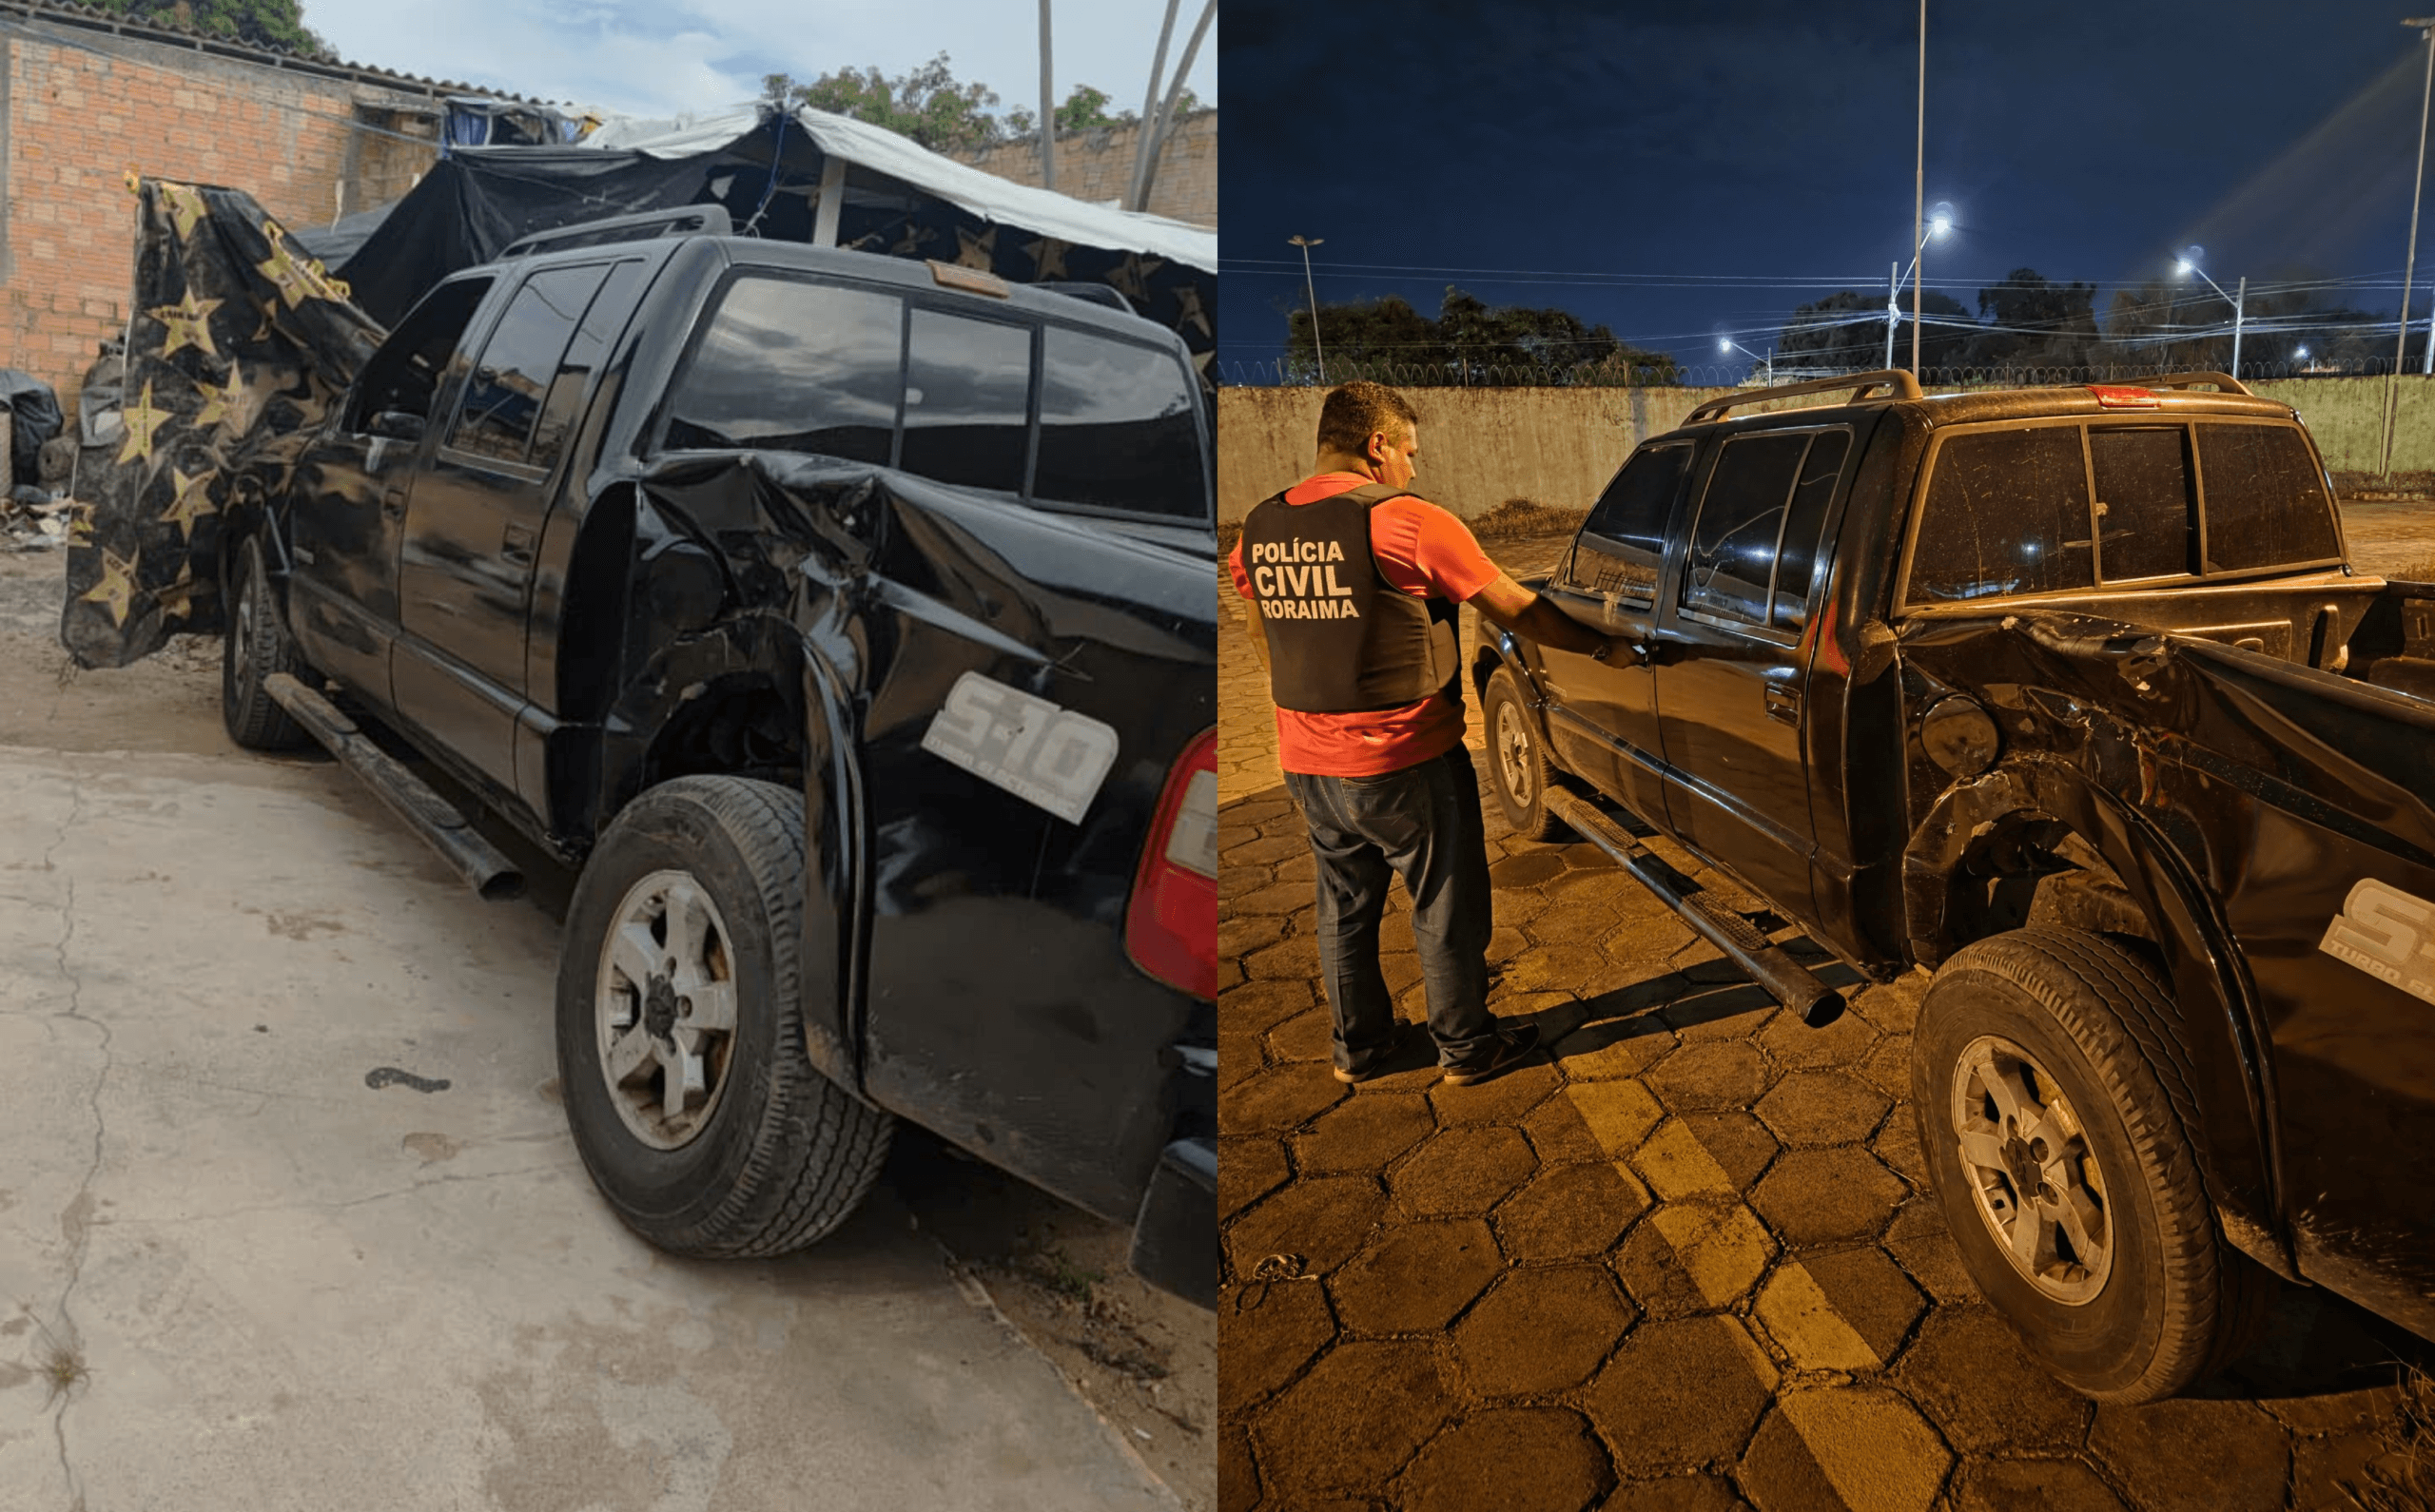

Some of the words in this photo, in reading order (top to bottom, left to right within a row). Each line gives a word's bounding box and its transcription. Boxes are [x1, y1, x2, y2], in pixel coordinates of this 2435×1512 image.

[1252, 537, 1345, 563] POLÍCIA
[1255, 565, 1353, 597] CIVIL
[1260, 598, 1360, 619] RORAIMA
[2331, 940, 2402, 983] TURBO
